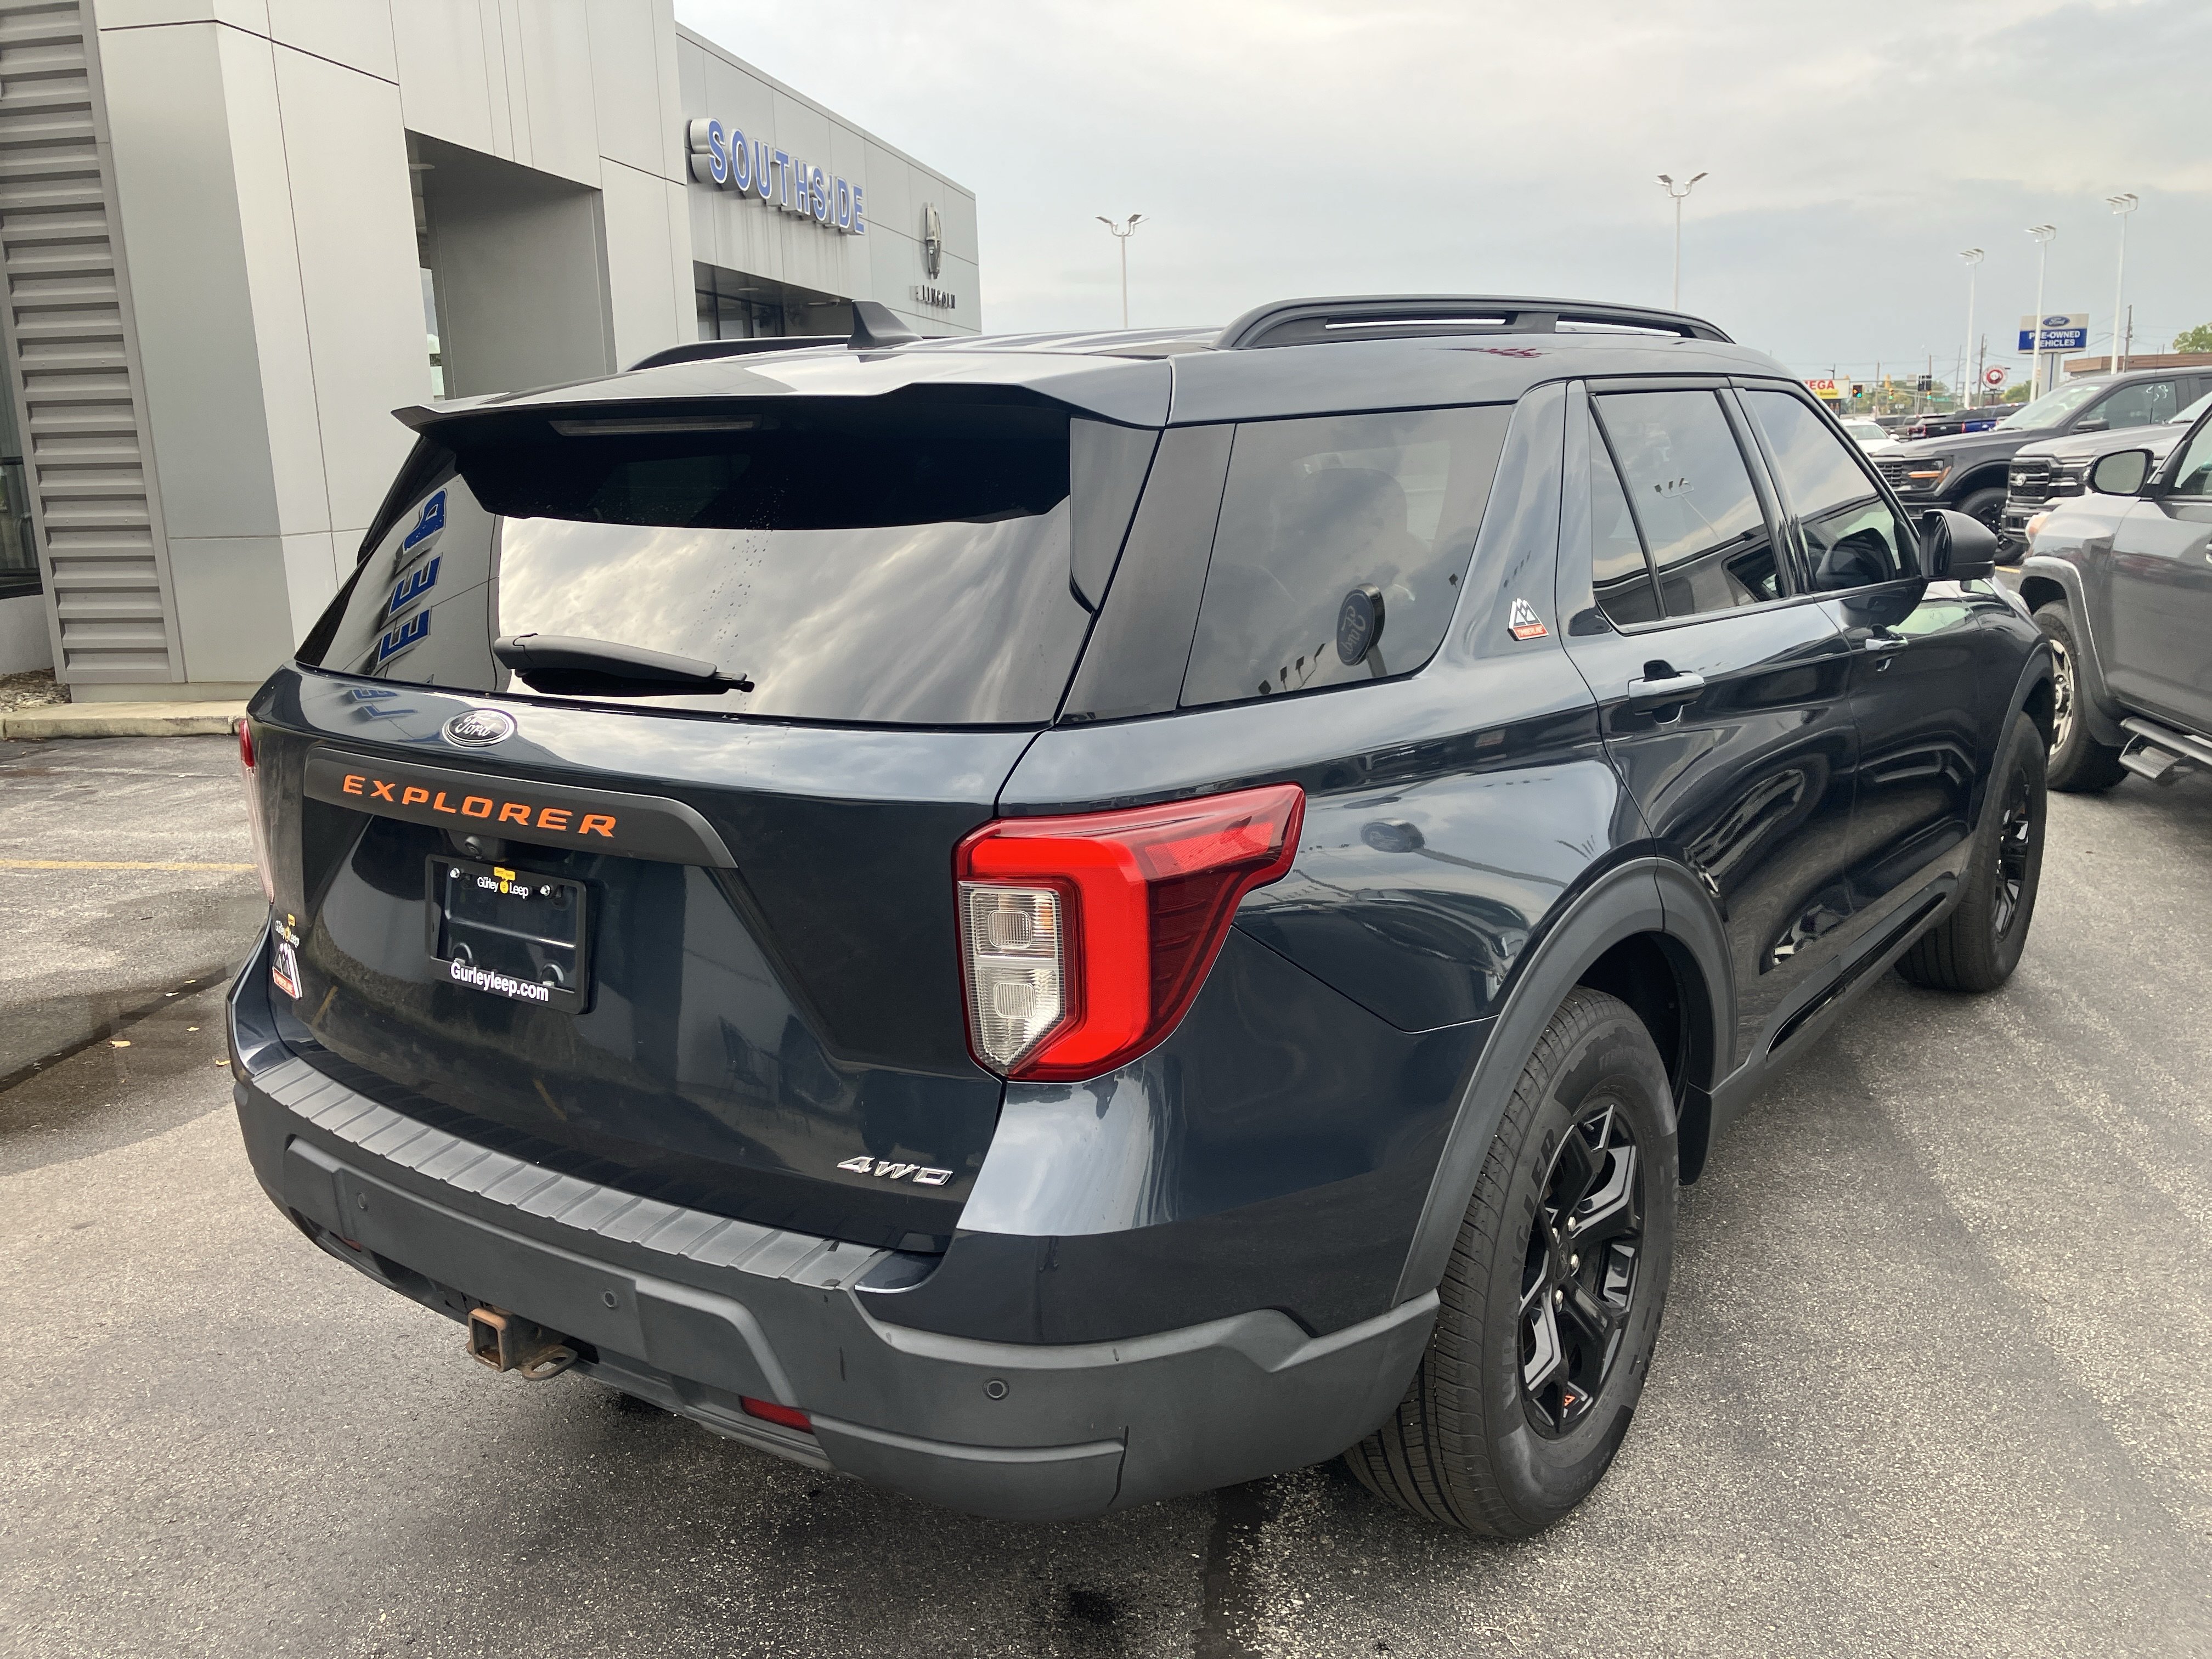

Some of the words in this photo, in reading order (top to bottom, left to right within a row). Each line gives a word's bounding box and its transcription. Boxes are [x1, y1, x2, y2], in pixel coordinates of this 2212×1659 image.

[706, 117, 866, 235] SOUTHSIDE
[916, 285, 956, 309] LINCOLN
[2048, 317, 2066, 325] Ford
[2028, 330, 2081, 339] PE-OWNED
[455, 712, 496, 737] Ford
[342, 774, 617, 838] EXPLORER
[509, 882, 529, 899] Leep
[450, 962, 549, 1002] Gurleyleep.com
[836, 1156, 953, 1186] 4WD
